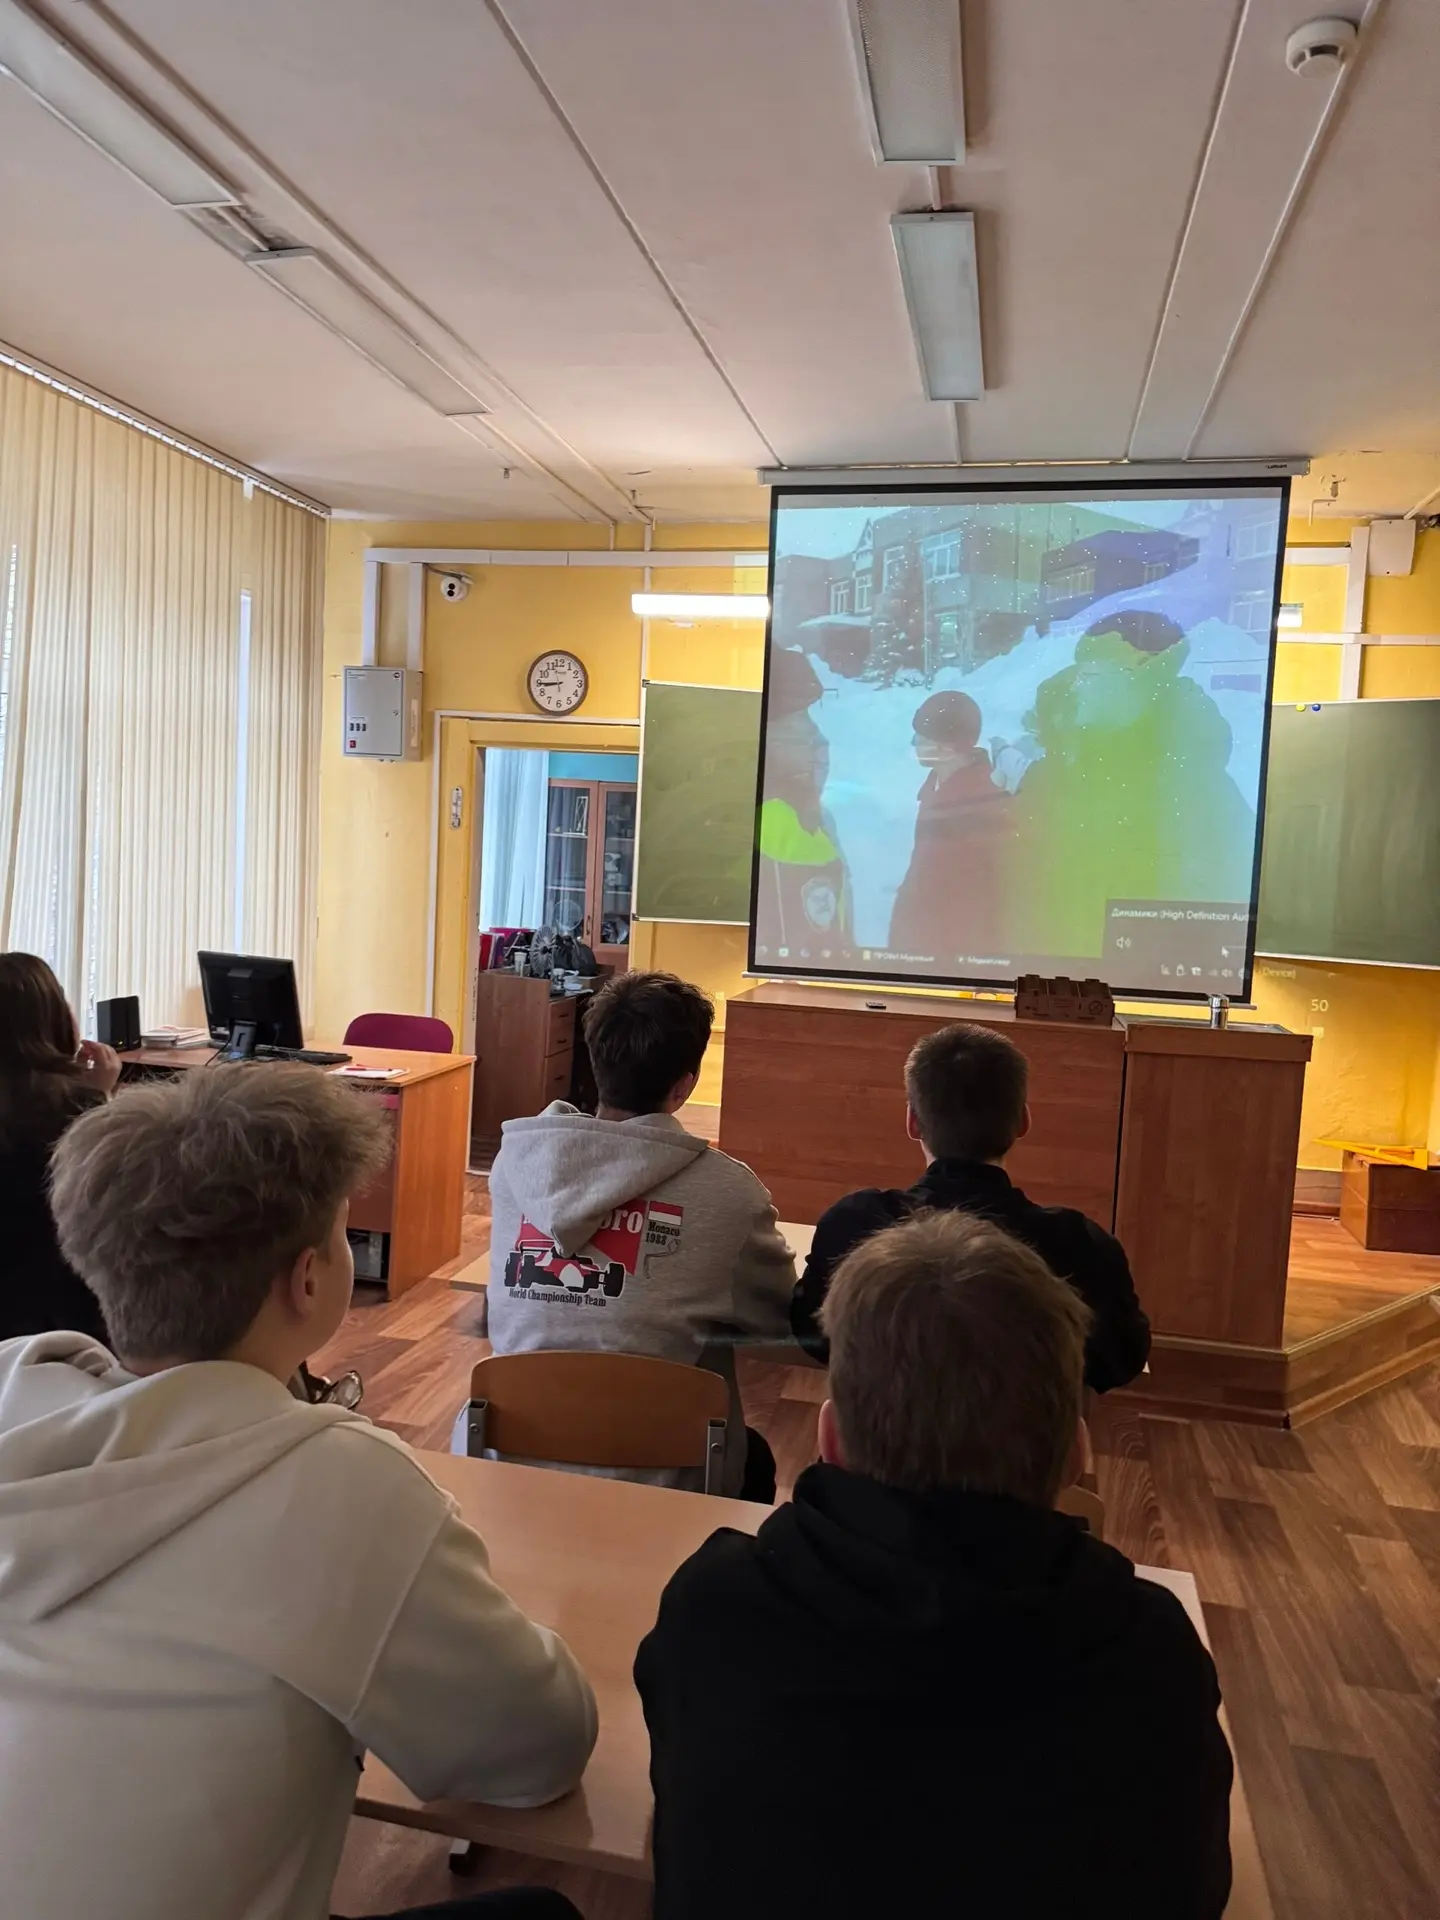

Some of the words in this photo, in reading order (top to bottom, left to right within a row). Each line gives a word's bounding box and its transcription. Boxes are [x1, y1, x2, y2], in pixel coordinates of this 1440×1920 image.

[546, 662, 556, 670] 11
[554, 659, 565, 667] 12
[567, 662, 572, 670] 1
[539, 670, 549, 678] 10
[572, 670, 579, 678] 2
[536, 679, 542, 687] 9
[576, 680, 583, 688] 3
[539, 688, 545, 696] 8
[572, 689, 578, 697] 4
[547, 696, 552, 704] 7
[556, 700, 562, 708] 6
[566, 697, 572, 705] 5
[1111, 908, 1158, 918] Динамики
[1186, 910, 1230, 921] Definition
[1310, 998, 1329, 1012] 50
[647, 1221, 680, 1236] Monaco
[509, 1288, 527, 1299] World
[527, 1289, 583, 1306] Championship
[583, 1294, 607, 1307] Team
